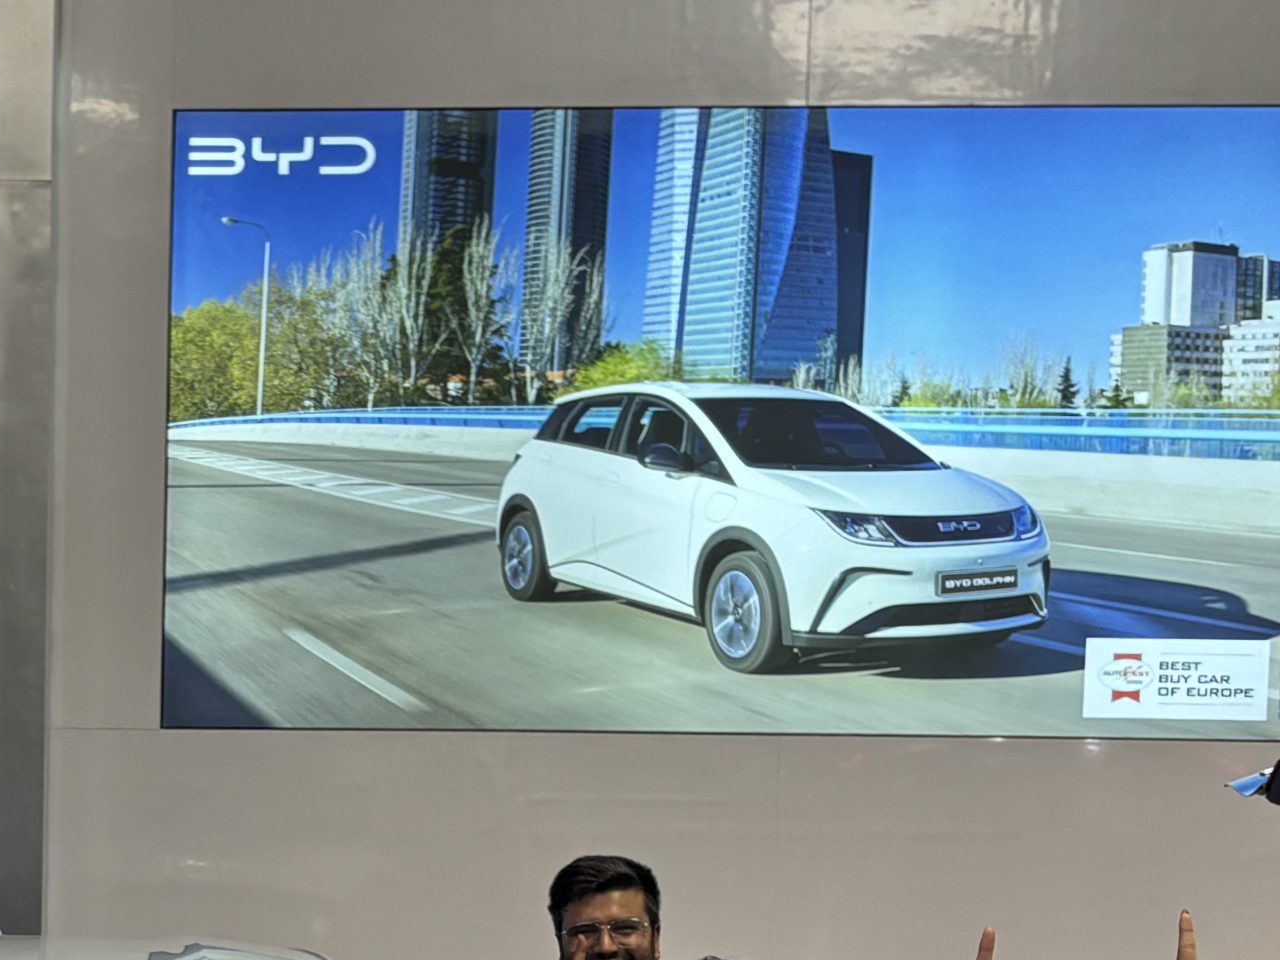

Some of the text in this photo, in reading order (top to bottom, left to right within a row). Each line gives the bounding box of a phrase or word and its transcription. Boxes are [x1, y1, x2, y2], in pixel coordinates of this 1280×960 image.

[187, 136, 377, 176] BYD
[936, 521, 981, 533] BYD
[1159, 661, 1202, 671] BEST
[1158, 675, 1231, 685] BUY CAR
[1157, 687, 1255, 698] OF EUROPE
